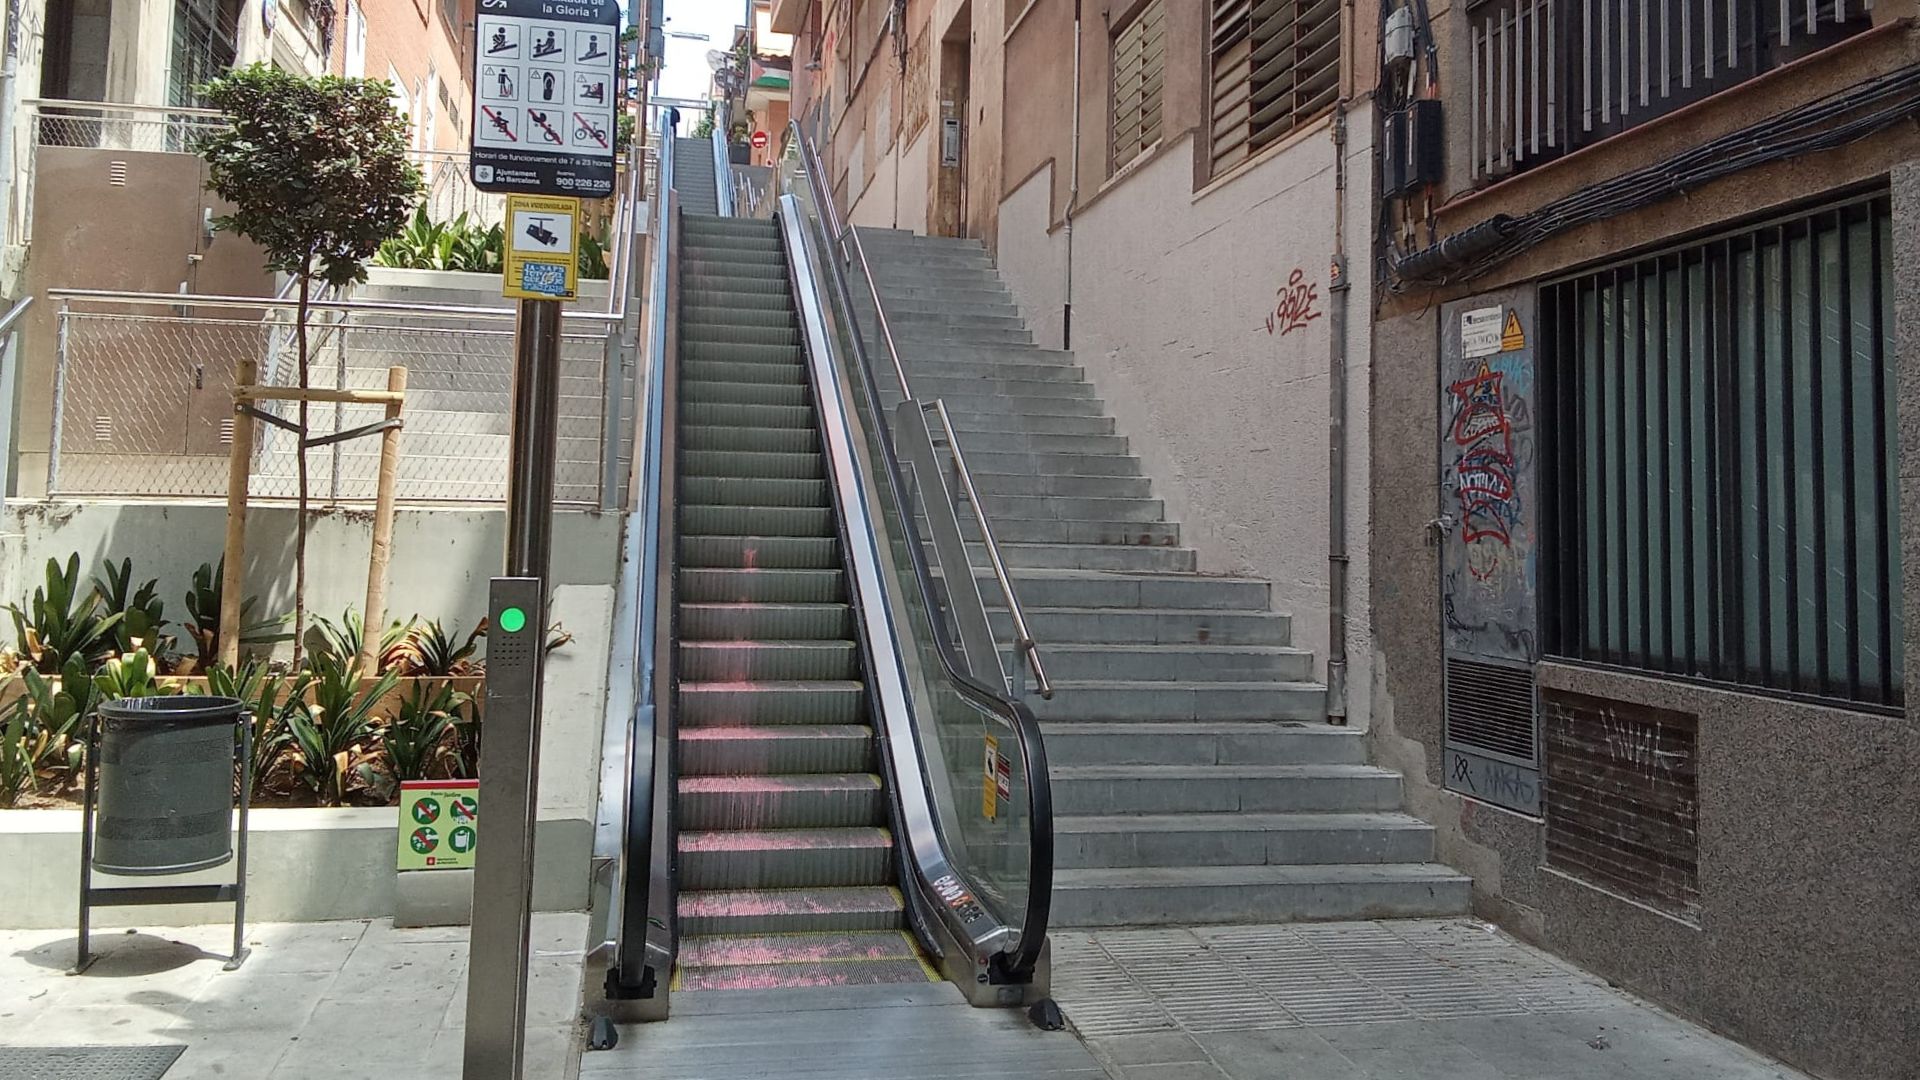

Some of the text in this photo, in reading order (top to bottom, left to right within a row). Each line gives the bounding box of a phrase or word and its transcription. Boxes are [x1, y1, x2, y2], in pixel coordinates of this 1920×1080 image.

[542, 3, 599, 18] la Gloria 1
[475, 152, 497, 160] Horari
[569, 157, 575, 165] 7
[496, 168, 537, 178] Ajuntament
[556, 177, 612, 189] 900 226 226
